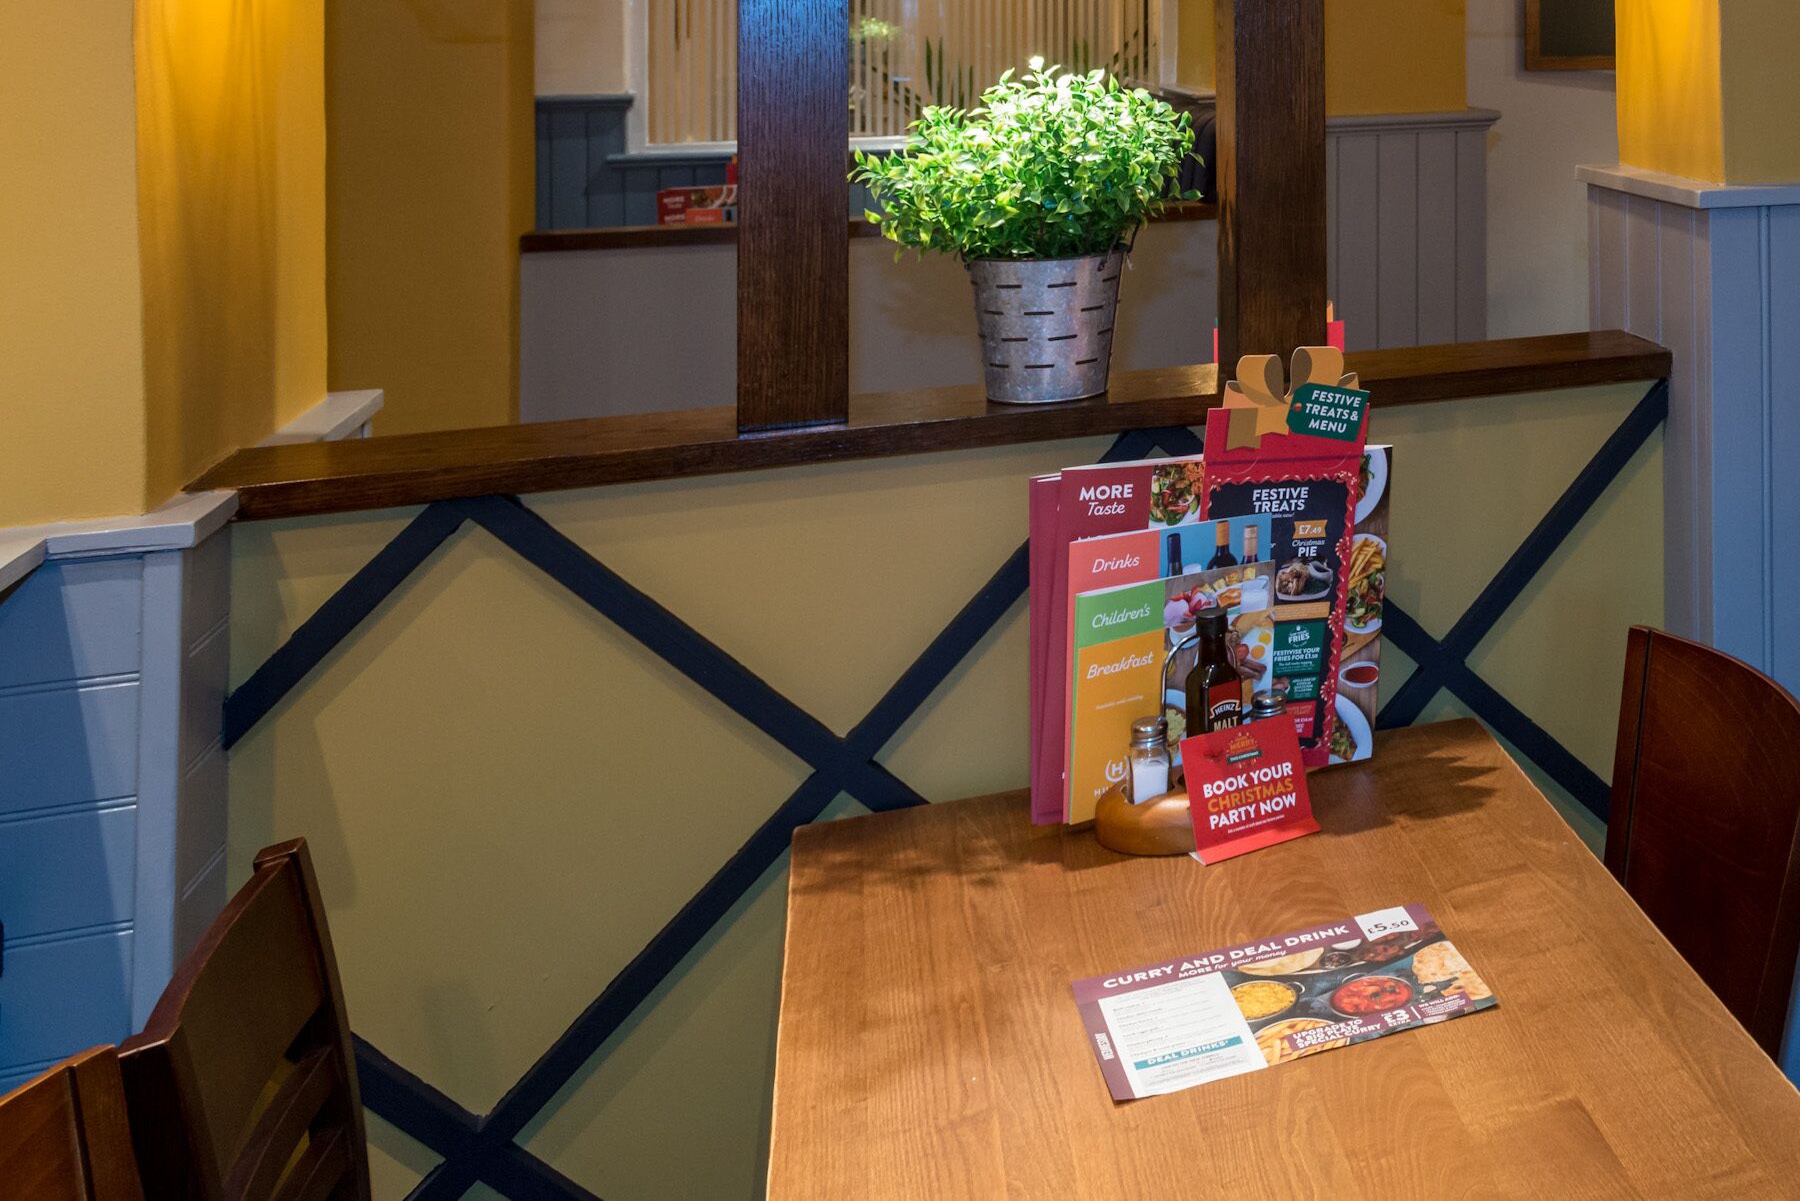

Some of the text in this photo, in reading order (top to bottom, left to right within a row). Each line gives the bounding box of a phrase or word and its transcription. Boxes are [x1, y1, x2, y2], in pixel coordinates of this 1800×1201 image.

[1312, 390, 1362, 408] FESTIVE
[1308, 418, 1347, 434] MENU
[1079, 484, 1134, 501] MORE
[1252, 487, 1309, 501] FESTIVE
[1088, 502, 1126, 516] Taste
[1254, 499, 1305, 513] TREATS
[1298, 524, 1322, 534] £7.49
[1292, 539, 1325, 547] Christmas
[1298, 546, 1318, 557] PIE
[1092, 554, 1140, 573] Drinks
[1092, 604, 1151, 628] Children's
[1288, 632, 1310, 644] FRIES
[1087, 652, 1154, 680] Breakfast
[1214, 704, 1236, 716] HEINZ
[1214, 716, 1238, 732] MALT
[1203, 762, 1293, 798] BOOK YOUR
[1208, 778, 1294, 812] CHRISTMAS
[1209, 804, 1256, 830] PARTY
[1260, 793, 1296, 815] NOW
[1368, 920, 1409, 934] £5.50
[1103, 925, 1350, 988] CURRY AND DEAL DRINK
[1178, 966, 1212, 978] MORE
[1214, 962, 1228, 971] for
[1231, 957, 1254, 967] your
[1383, 1009, 1410, 1022] £3
[1293, 1019, 1363, 1039] UPGRADE TO
[1298, 1023, 1381, 1048] SPECIAL CURRY
[1304, 1032, 1325, 1042] BIG
[1326, 1024, 1360, 1037] PLATE
[1147, 1052, 1179, 1065] DEAL
